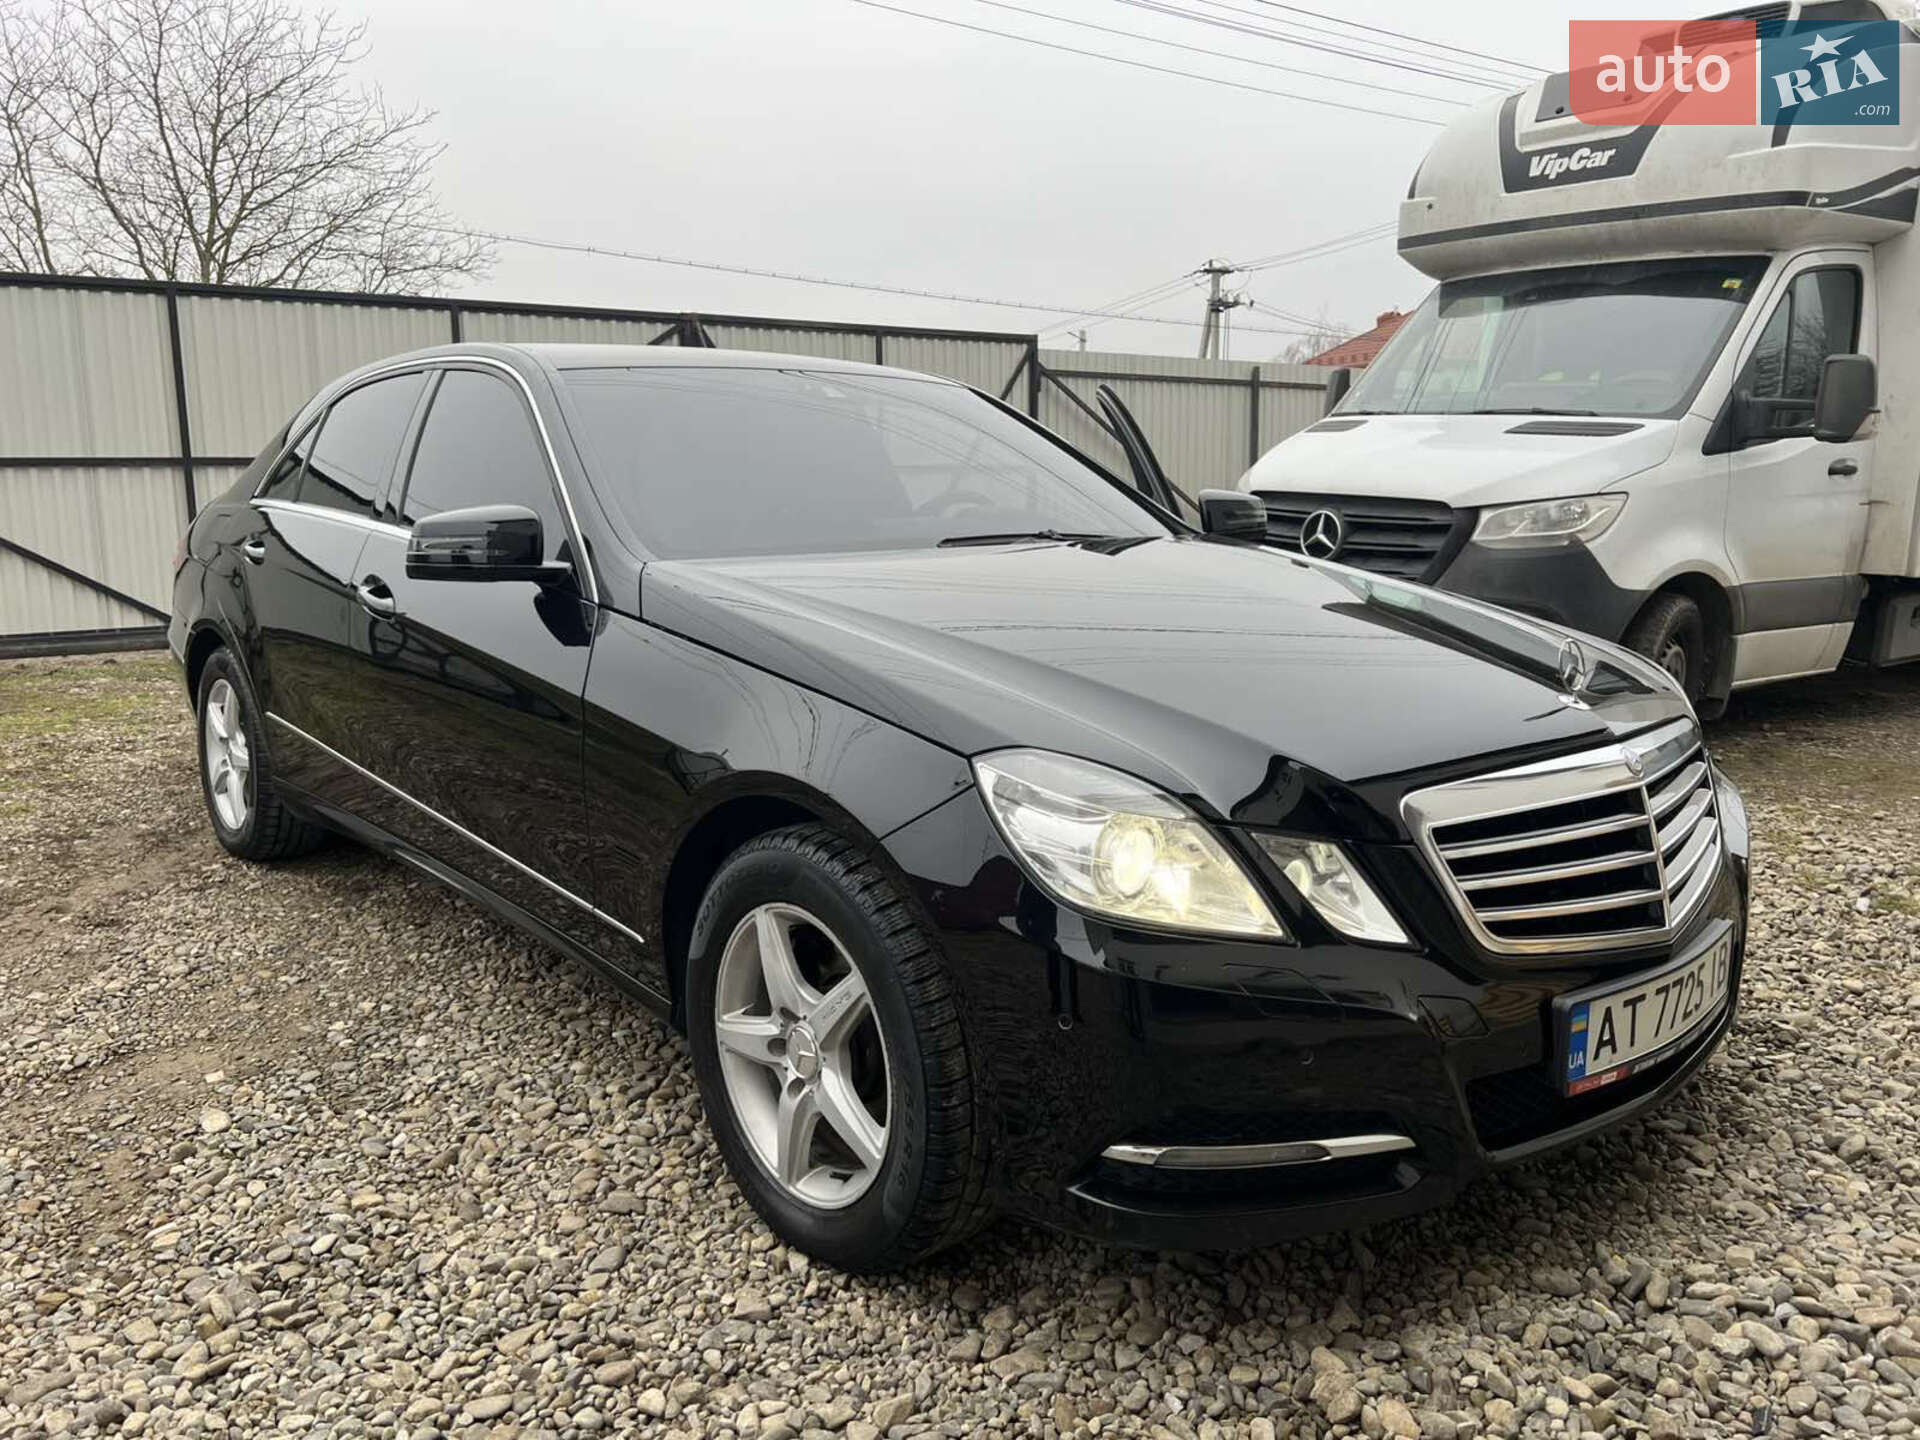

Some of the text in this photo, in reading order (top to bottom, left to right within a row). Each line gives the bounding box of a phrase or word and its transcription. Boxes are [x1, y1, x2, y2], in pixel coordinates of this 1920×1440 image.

[1528, 147, 1617, 180] VipCar
[1593, 993, 1648, 1062] AT
[1654, 962, 1706, 1038] 7725
[1568, 1051, 1585, 1069] UA
